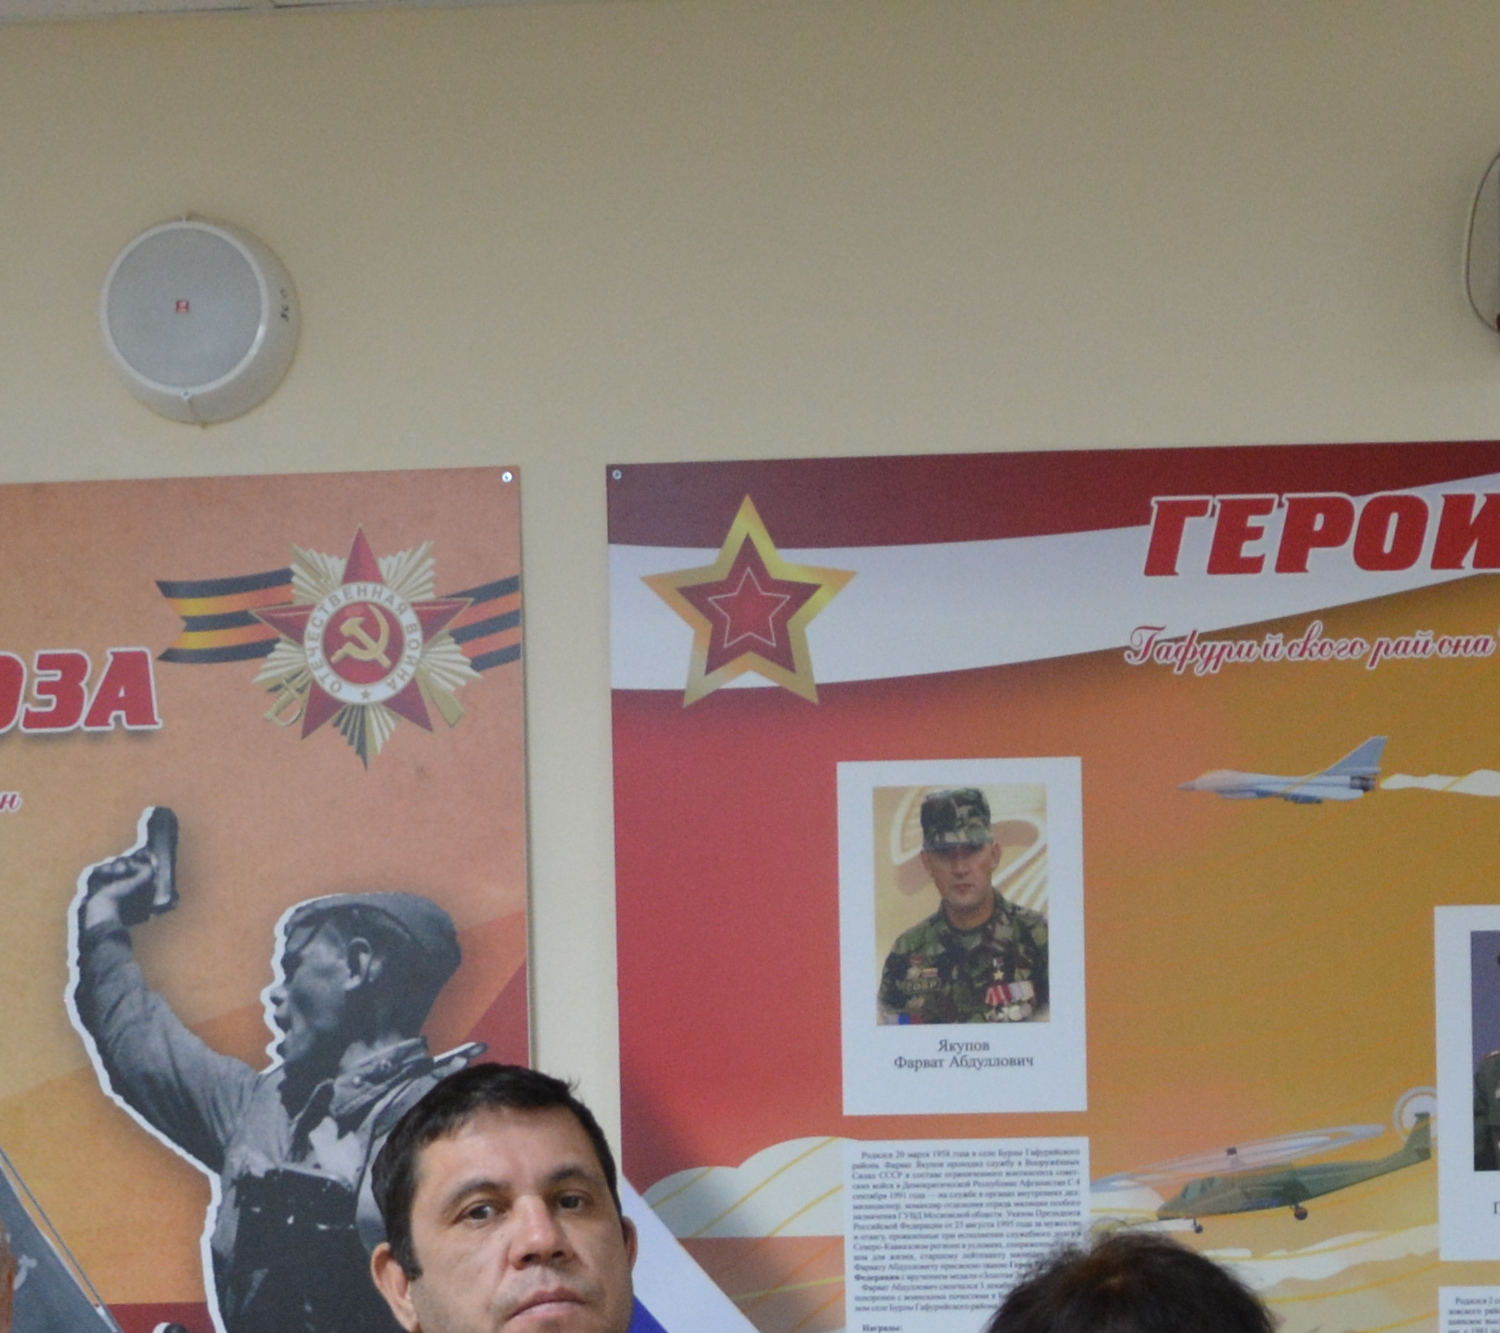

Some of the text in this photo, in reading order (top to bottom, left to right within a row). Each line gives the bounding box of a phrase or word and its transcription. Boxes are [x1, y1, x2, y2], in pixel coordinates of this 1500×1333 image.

[307, 585, 409, 694] ОТЕЧЕСТВЕННАЯ
[1124, 620, 1366, 677] Гафурийского
[1368, 626, 1495, 671] района
[893, 1053, 1035, 1071] Фарват Абдуллович
[937, 1039, 990, 1053] Якупов
